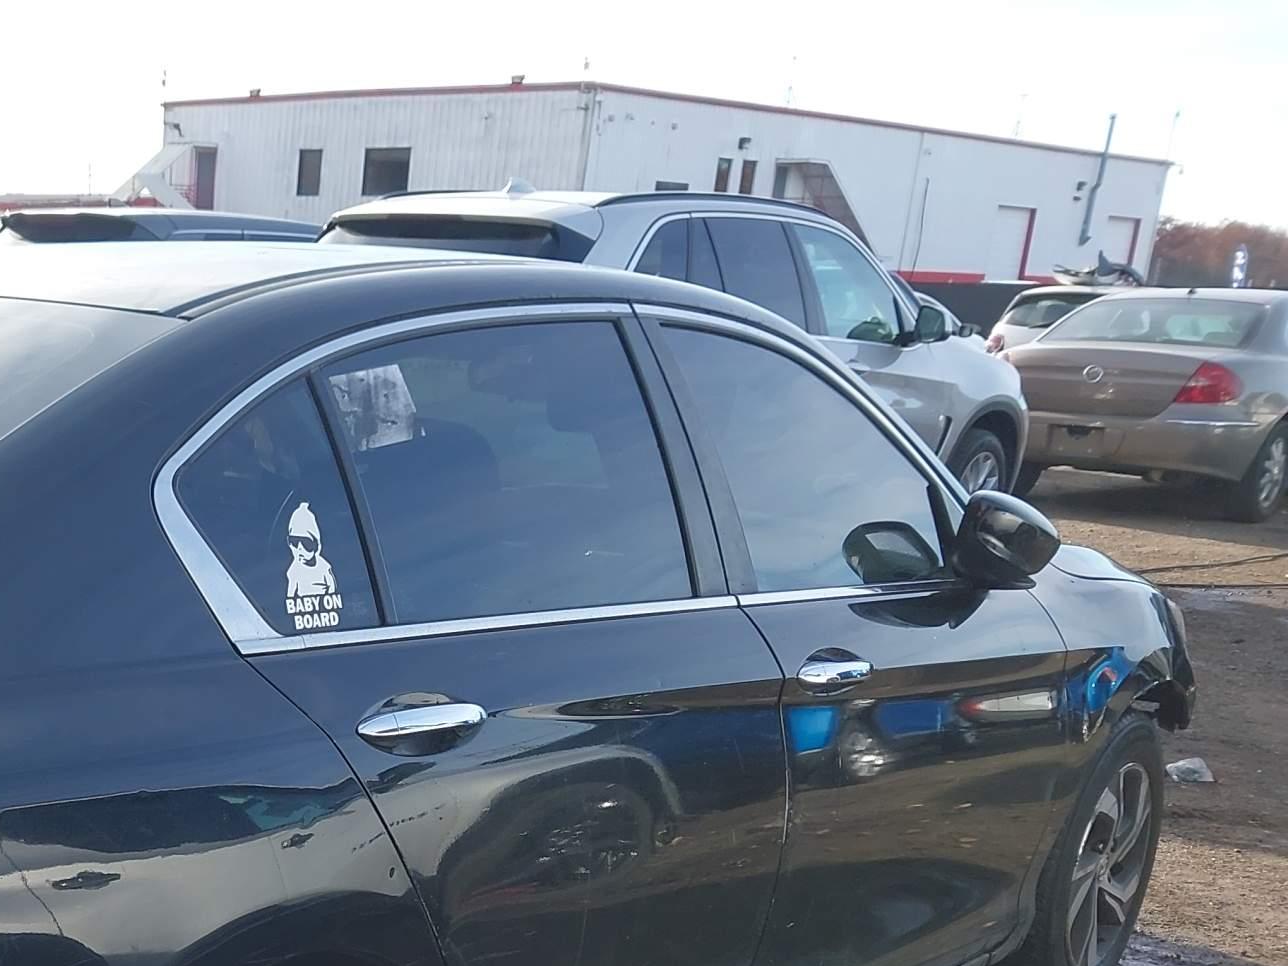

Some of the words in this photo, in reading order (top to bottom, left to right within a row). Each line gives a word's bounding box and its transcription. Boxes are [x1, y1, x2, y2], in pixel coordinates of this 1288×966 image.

[286, 596, 320, 614] BABY
[323, 594, 343, 610] ON
[294, 611, 340, 630] BOARD
